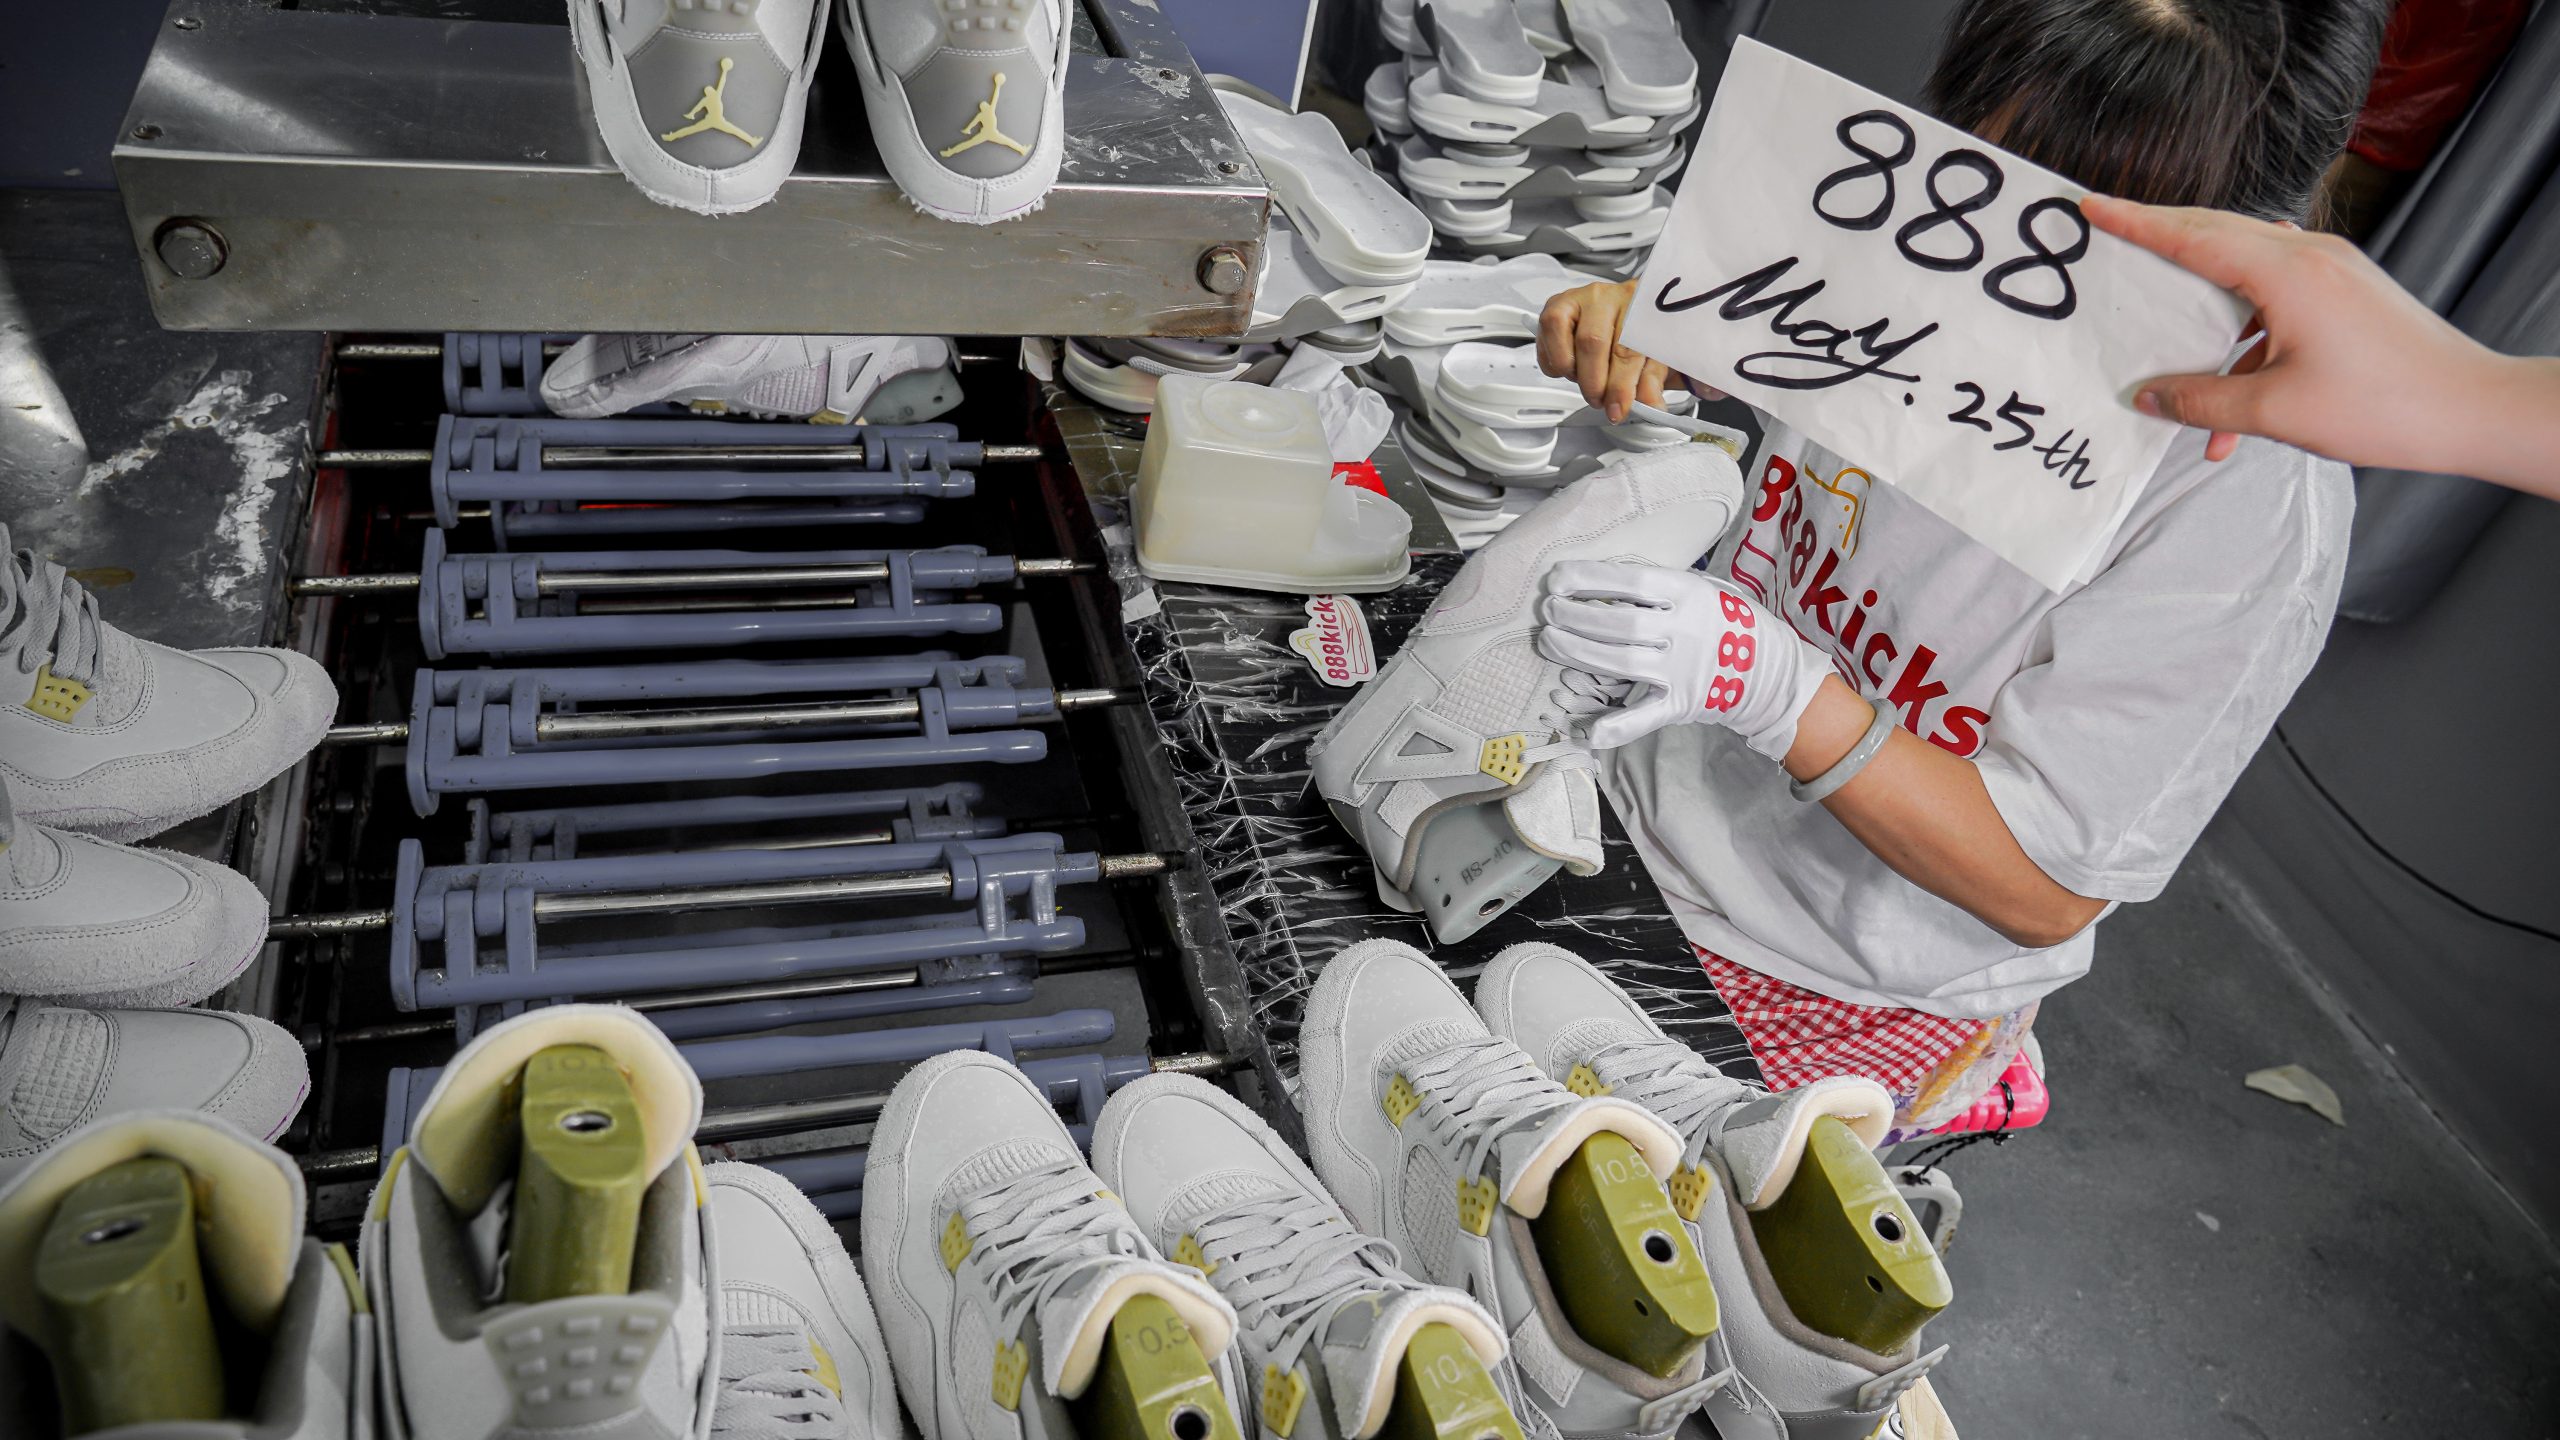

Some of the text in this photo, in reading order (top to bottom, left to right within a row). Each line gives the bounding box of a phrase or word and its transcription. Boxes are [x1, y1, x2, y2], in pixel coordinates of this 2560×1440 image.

[1812, 109, 2091, 321] 888
[1947, 381, 2097, 490] 25th
[1704, 590, 1757, 714] 888
[1752, 454, 1992, 757] 888kicks
[1593, 1153, 1650, 1187] 10.5
